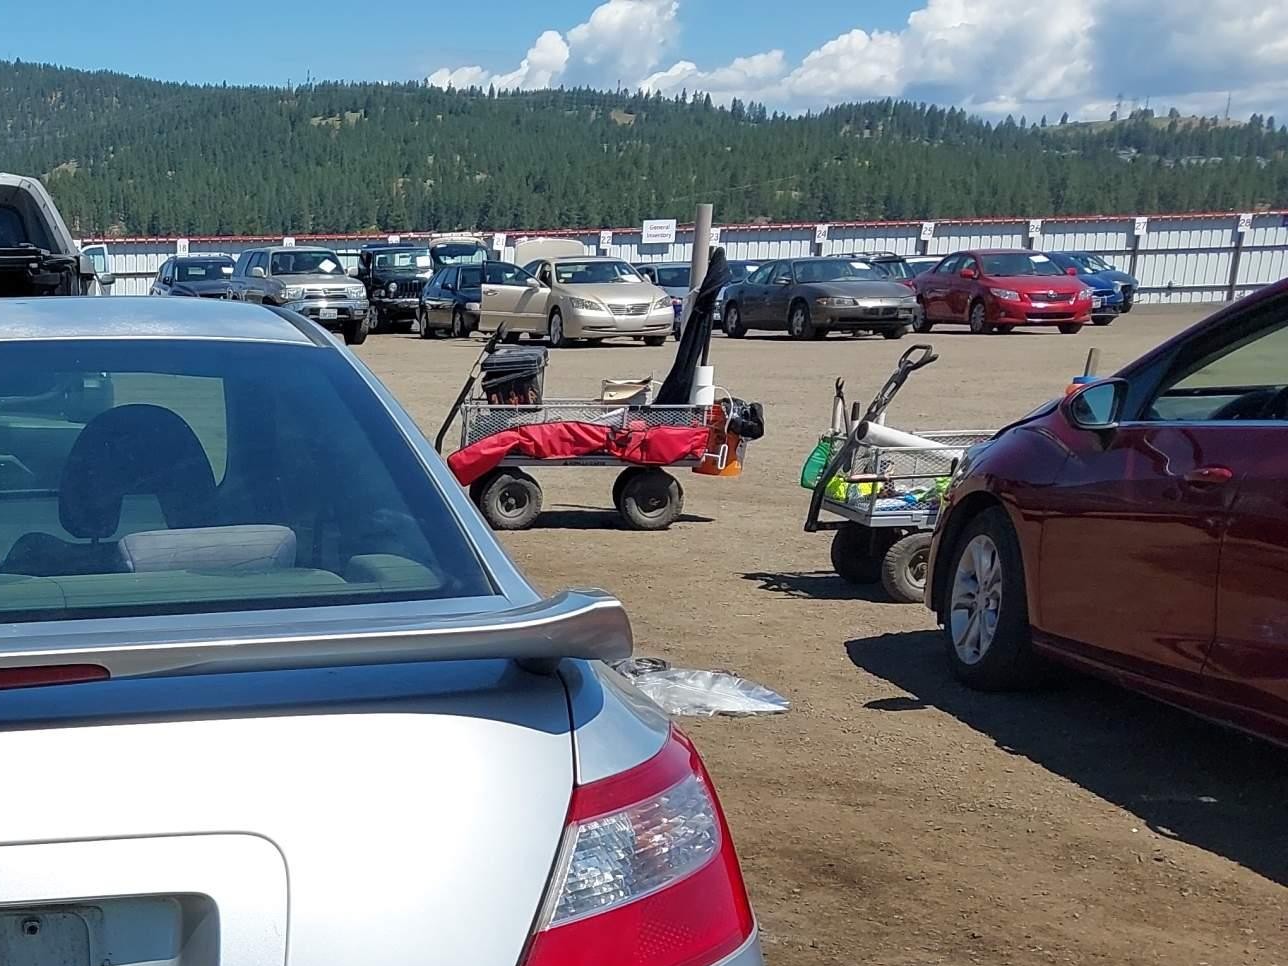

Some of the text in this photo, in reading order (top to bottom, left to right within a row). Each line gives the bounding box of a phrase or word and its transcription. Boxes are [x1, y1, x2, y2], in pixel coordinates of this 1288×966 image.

[1134, 221, 1147, 231] 27
[1239, 218, 1252, 228] 28
[923, 226, 933, 236] 25
[1029, 224, 1041, 233] 26
[816, 230, 827, 239] 24
[601, 235, 612, 245] 22
